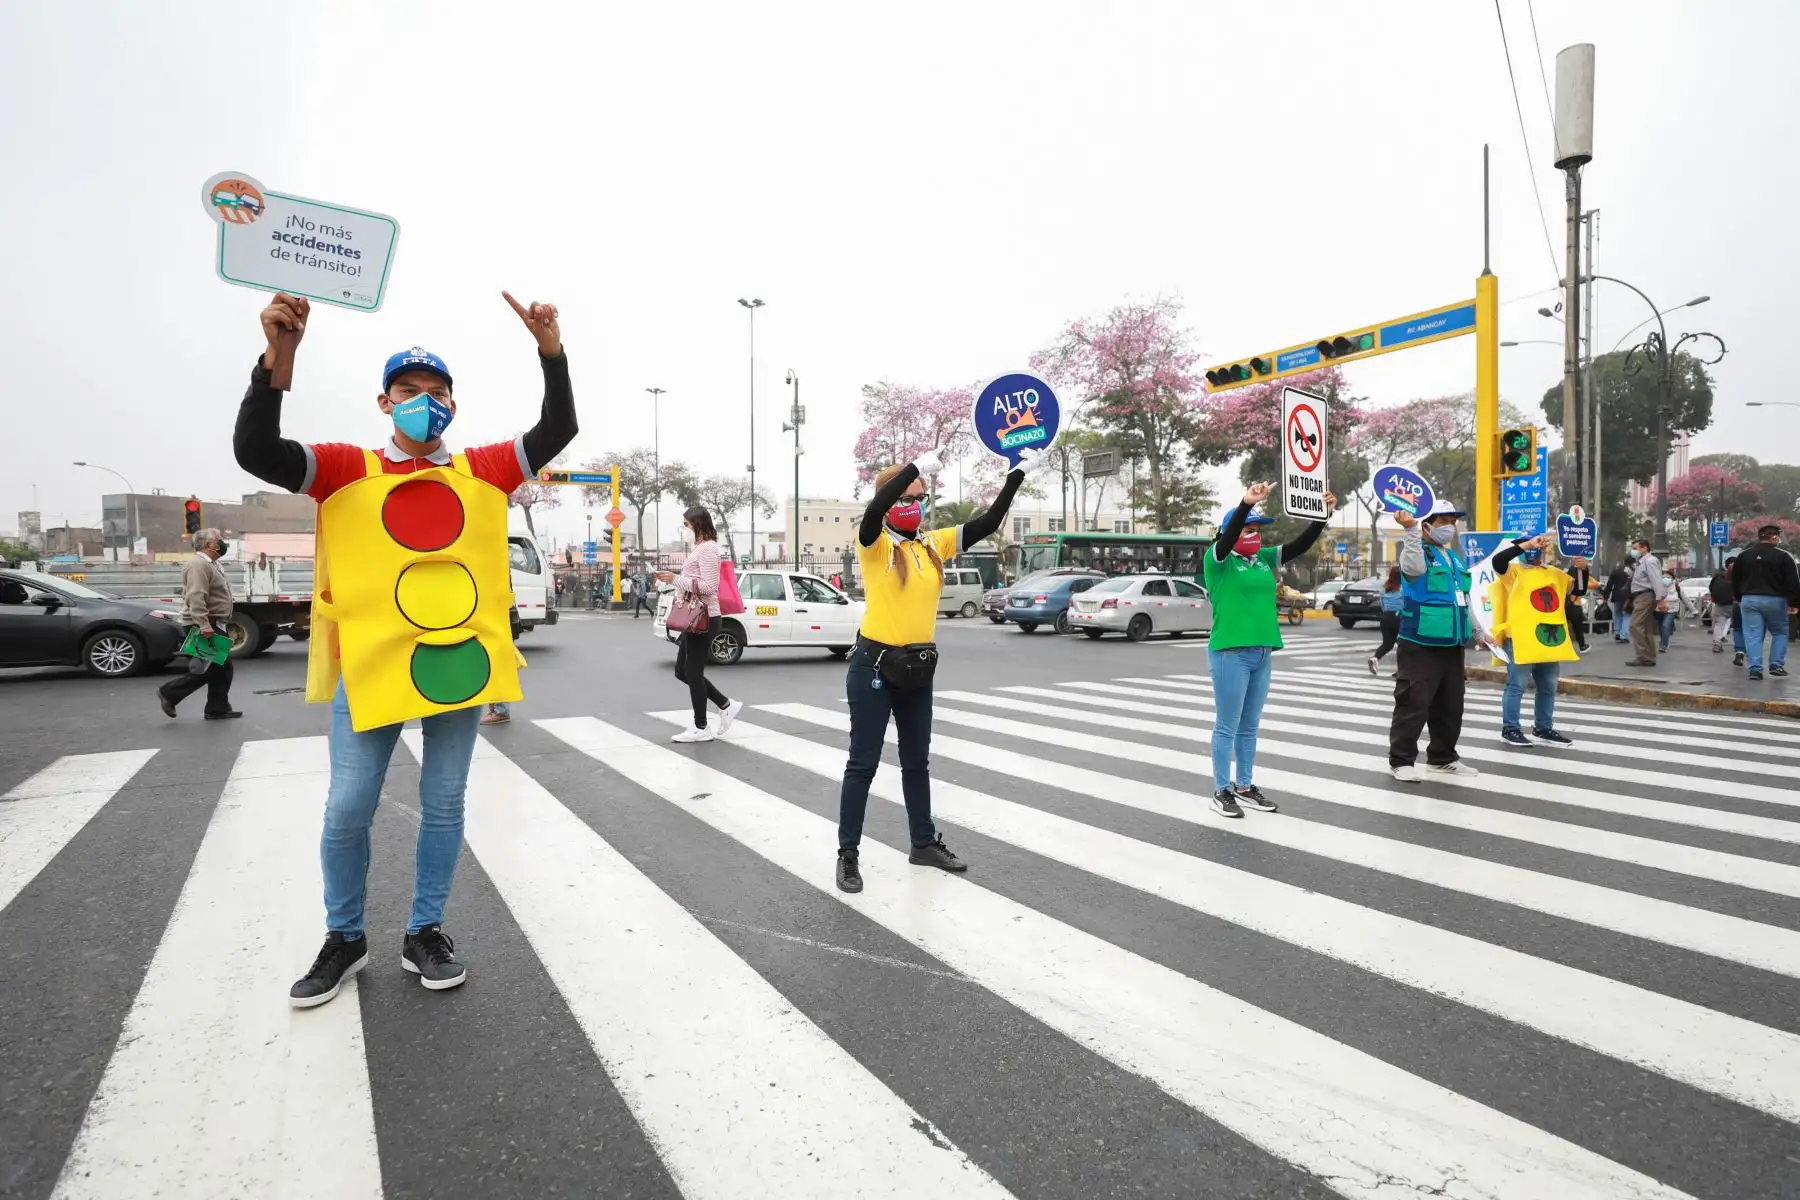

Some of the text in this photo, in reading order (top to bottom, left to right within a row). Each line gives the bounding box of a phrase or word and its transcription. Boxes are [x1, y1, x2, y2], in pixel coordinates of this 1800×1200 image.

[286, 214, 353, 241] ¡No más
[271, 230, 361, 260] accidentes
[270, 246, 362, 278] de tránsito!
[993, 388, 1040, 416] ALTO
[1002, 429, 1044, 447] BOCINAZO
[1289, 474, 1323, 493] NO TOCAR
[1388, 474, 1423, 497] ALTO
[1290, 494, 1323, 512] BOCINA
